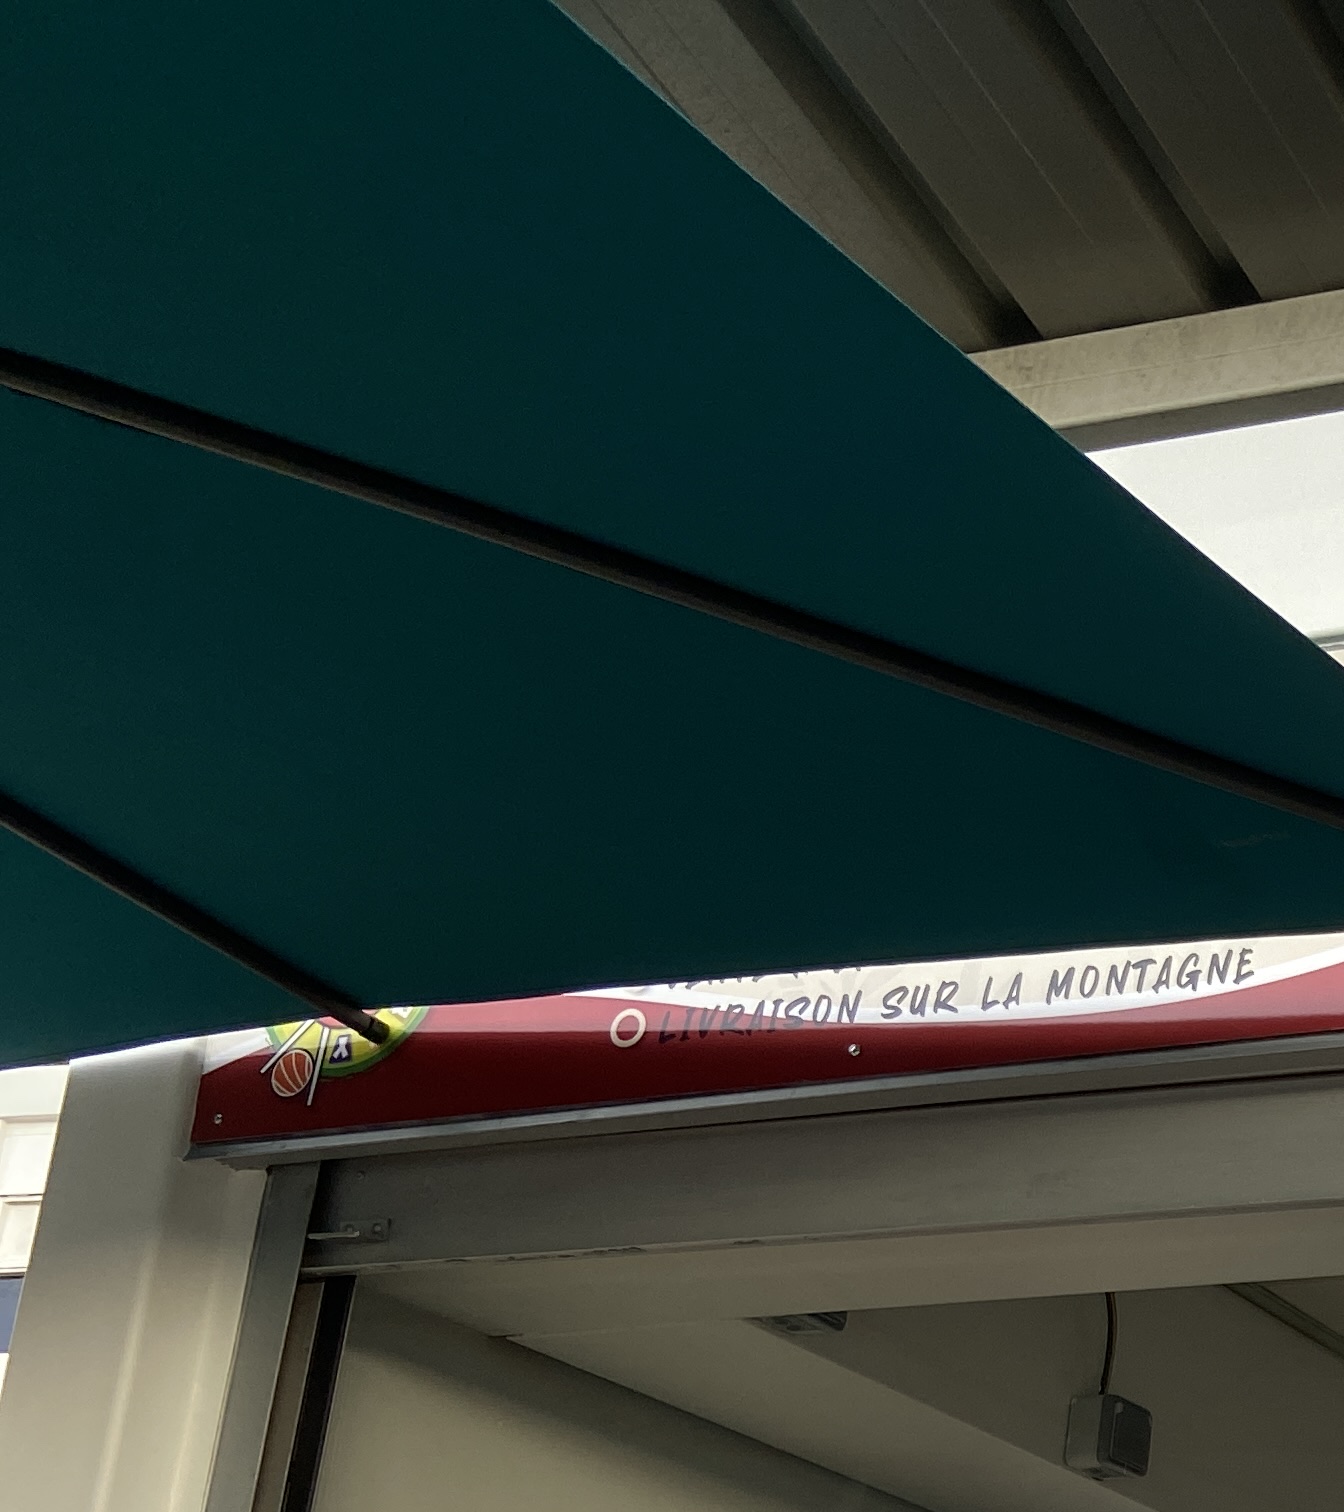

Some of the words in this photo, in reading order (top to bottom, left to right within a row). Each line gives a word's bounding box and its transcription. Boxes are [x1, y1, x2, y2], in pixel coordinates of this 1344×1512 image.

[657, 990, 863, 1044] LIVRAISON
[880, 981, 960, 1020] SUR
[981, 971, 1025, 1012] LA
[1045, 946, 1258, 1005] MONTAGNE
